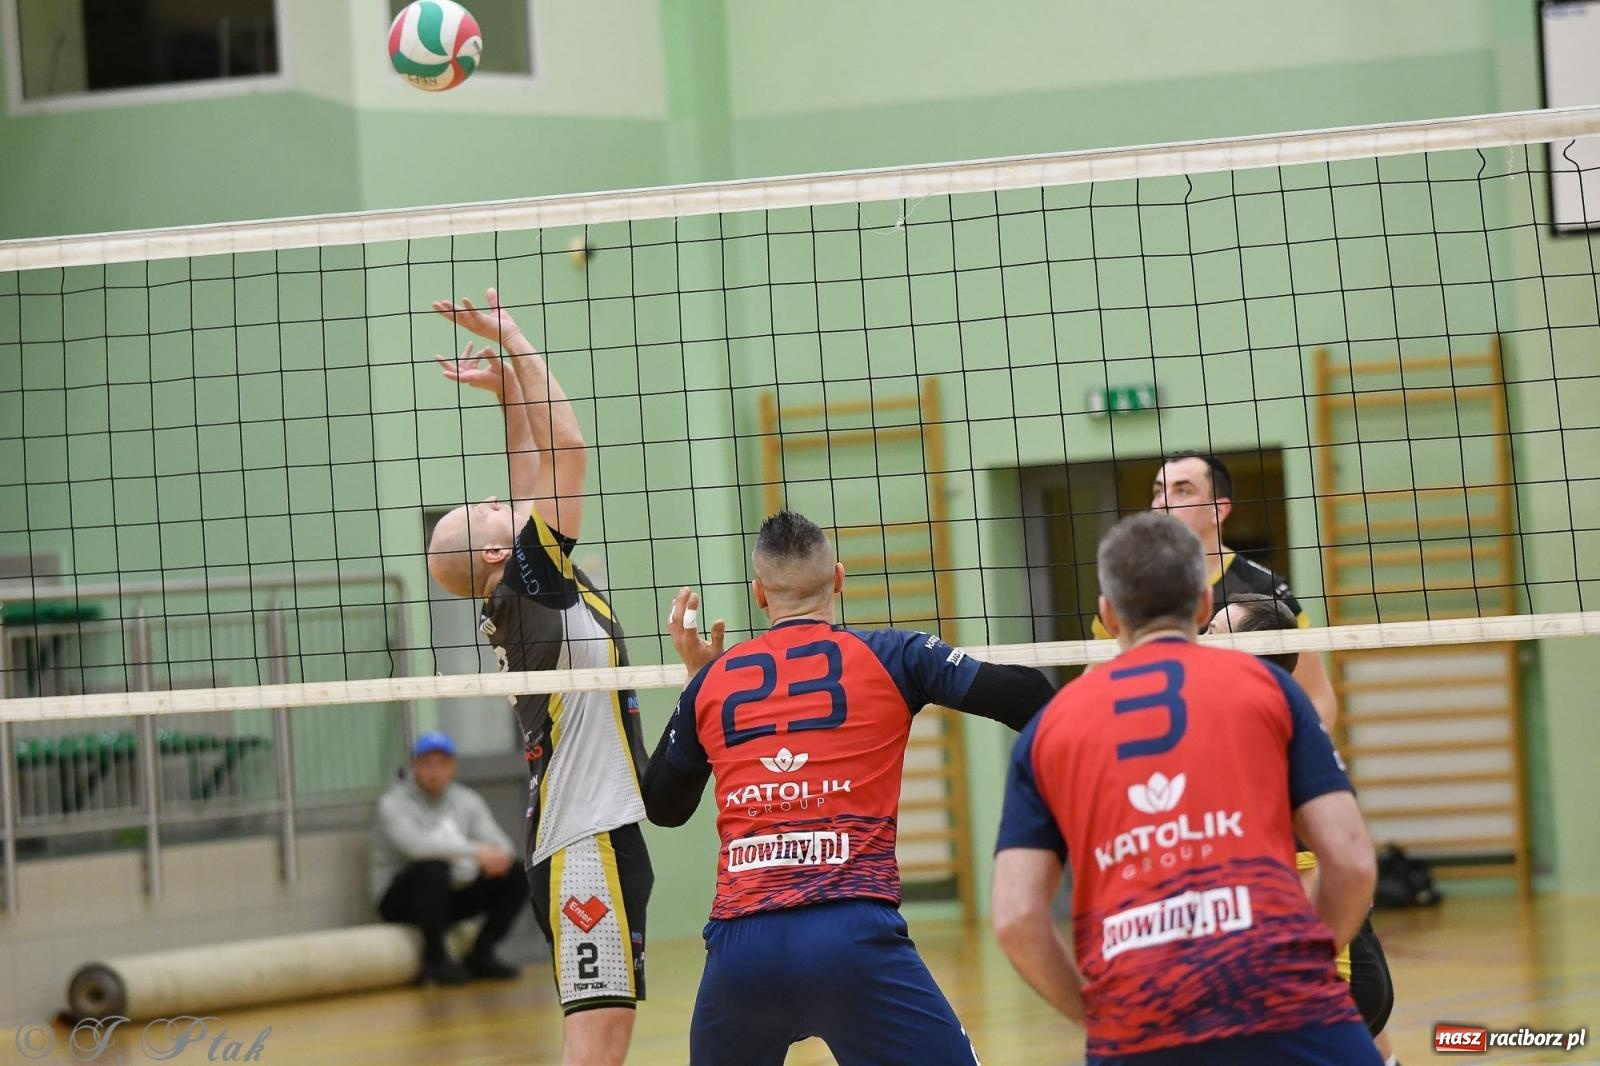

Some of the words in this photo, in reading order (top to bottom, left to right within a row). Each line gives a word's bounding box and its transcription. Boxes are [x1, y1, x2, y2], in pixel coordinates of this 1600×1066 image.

[721, 639, 848, 749] 23
[1110, 659, 1188, 761] 3
[725, 779, 852, 808] KATOLIK
[747, 797, 826, 818] GROUP
[729, 831, 846, 869] nowiny.pl
[1094, 811, 1244, 871] KATOLIK
[1121, 844, 1214, 881] GROUP
[568, 900, 593, 924] Enter
[1103, 898, 1243, 951] nowiny.pl
[576, 942, 599, 980] 2
